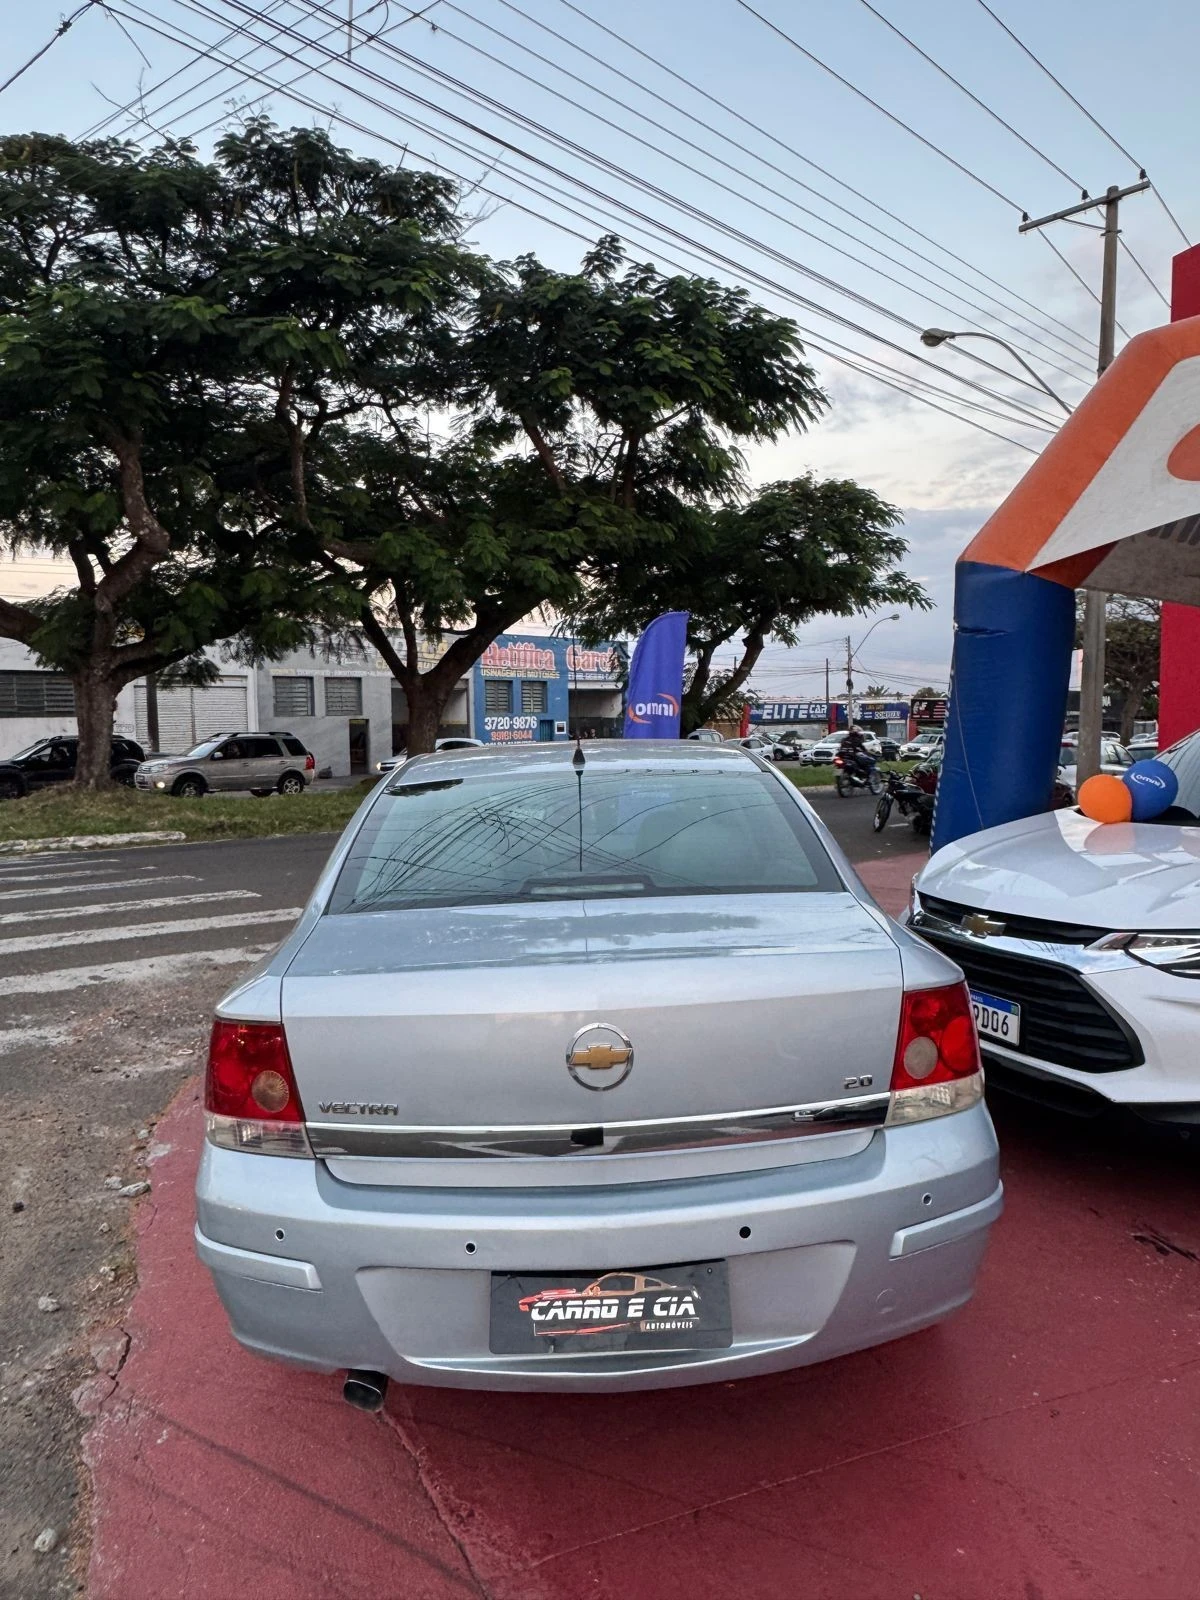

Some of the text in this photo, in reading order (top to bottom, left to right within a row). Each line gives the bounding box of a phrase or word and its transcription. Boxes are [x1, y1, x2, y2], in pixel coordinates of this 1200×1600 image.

[635, 702, 674, 717] omni
[762, 704, 809, 719] ELITE
[809, 704, 828, 714] CAR
[1136, 774, 1162, 787] omni
[318, 1101, 399, 1116] VECTRA
[531, 1296, 696, 1321] CARRO E CIA
